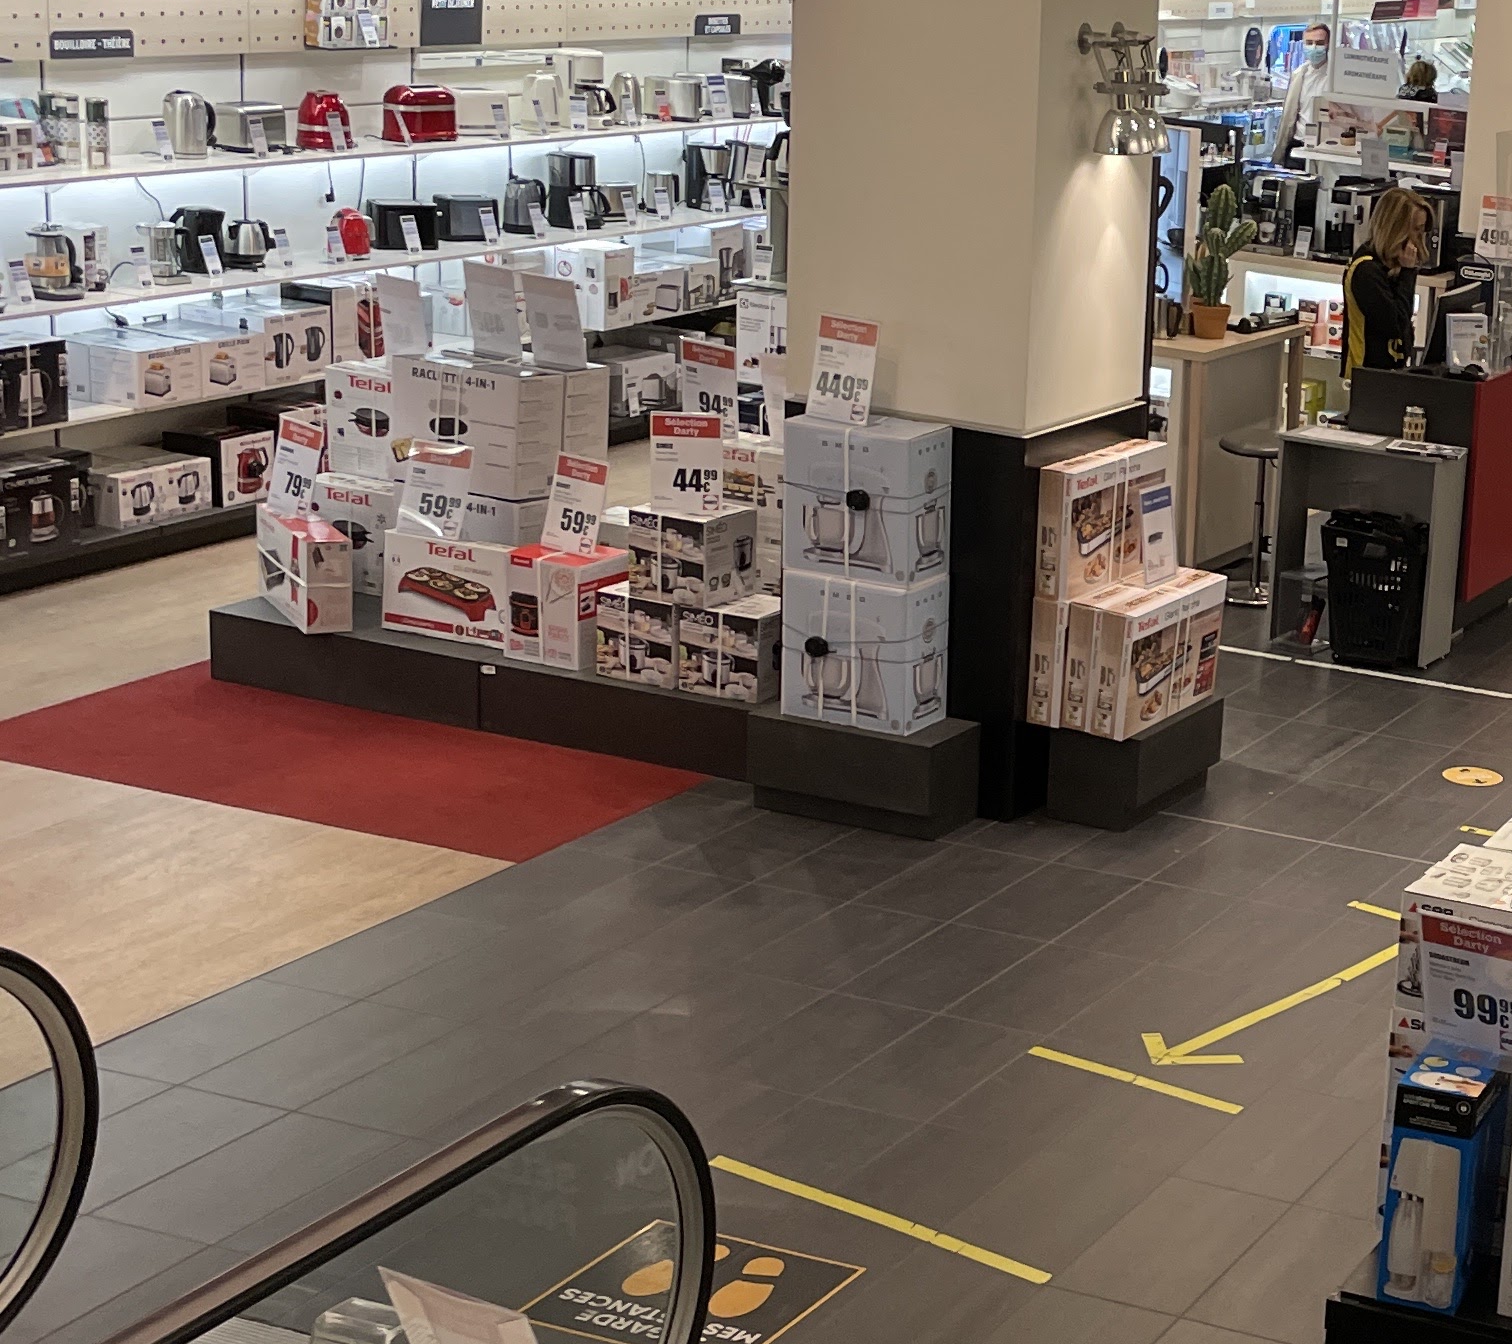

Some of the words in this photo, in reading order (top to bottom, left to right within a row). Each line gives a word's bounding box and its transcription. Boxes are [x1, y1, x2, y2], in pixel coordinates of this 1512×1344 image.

[1480, 228, 1509, 246] 499
[348, 374, 391, 394] Tefal
[412, 367, 461, 383] RACLTT
[466, 377, 496, 391] 4-IN-1
[816, 371, 855, 402] 449
[699, 391, 721, 414] 94
[664, 417, 708, 428] Sélection
[673, 427, 699, 437] Darty
[284, 471, 302, 498] 79
[673, 468, 704, 492] 44
[704, 470, 718, 481] 99
[325, 487, 372, 506] Tefal
[419, 492, 447, 518] 59
[466, 503, 496, 516] 4-IN-1
[560, 508, 585, 534] 59
[585, 514, 597, 525] 99
[426, 541, 476, 562] Tefal
[1439, 921, 1502, 945] Sélection
[1453, 936, 1489, 954] Darty
[1453, 988, 1498, 1025] 99
[574, 1309, 662, 1340] GARDE
[702, 1323, 762, 1344] MES
